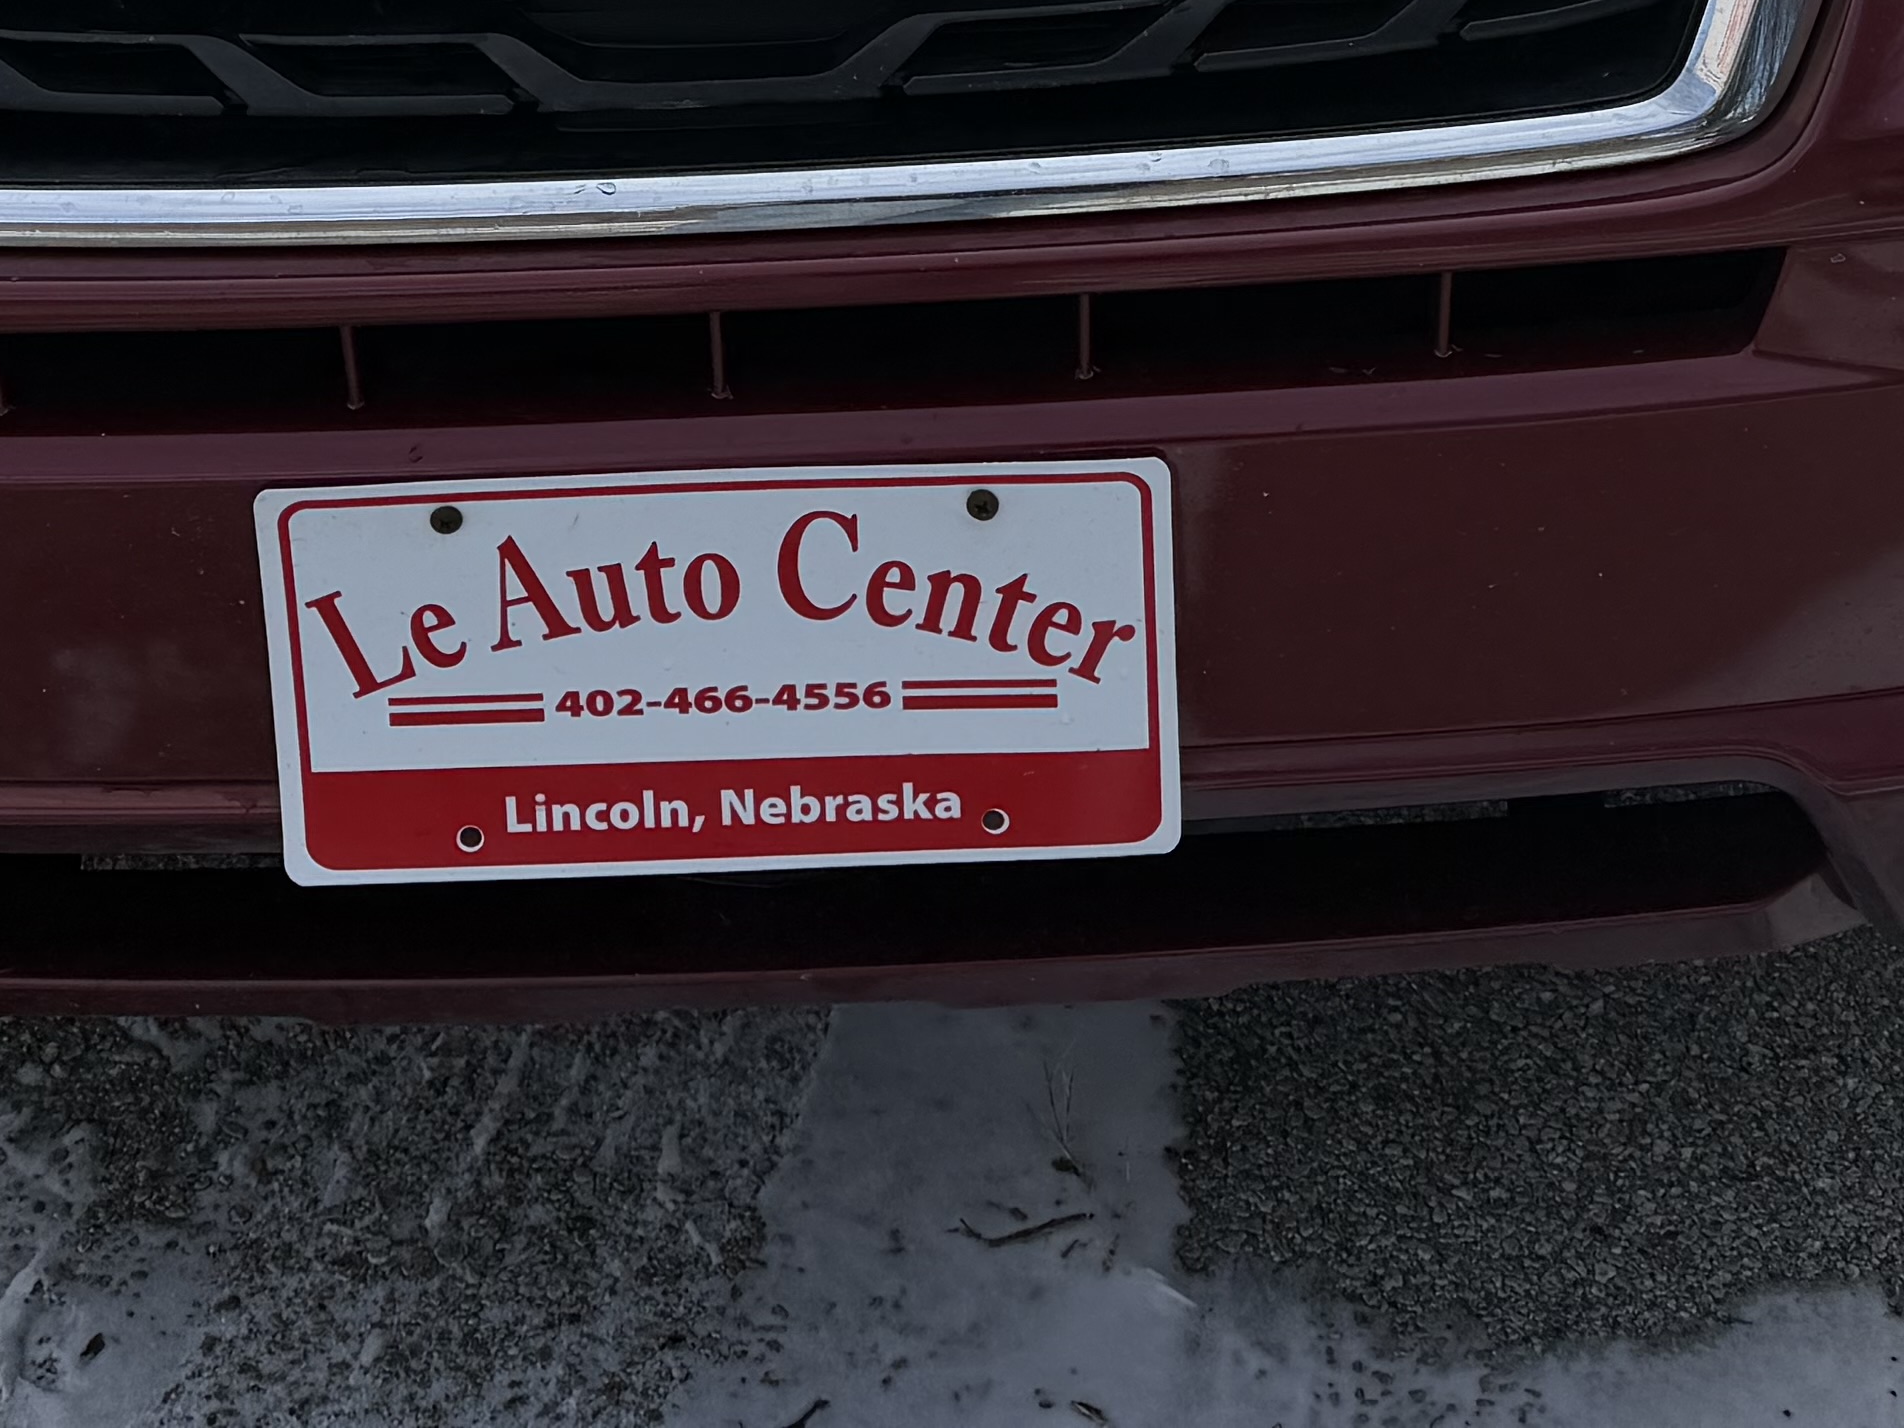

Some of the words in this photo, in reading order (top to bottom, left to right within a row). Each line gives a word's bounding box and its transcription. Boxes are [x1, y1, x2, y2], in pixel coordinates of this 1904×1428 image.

[305, 589, 467, 699] Le
[490, 534, 742, 653] Auto
[776, 510, 1137, 685] Center
[554, 680, 893, 719] 402-466-4556
[504, 789, 707, 836] Lincoln,
[720, 782, 963, 828] Nebraska
